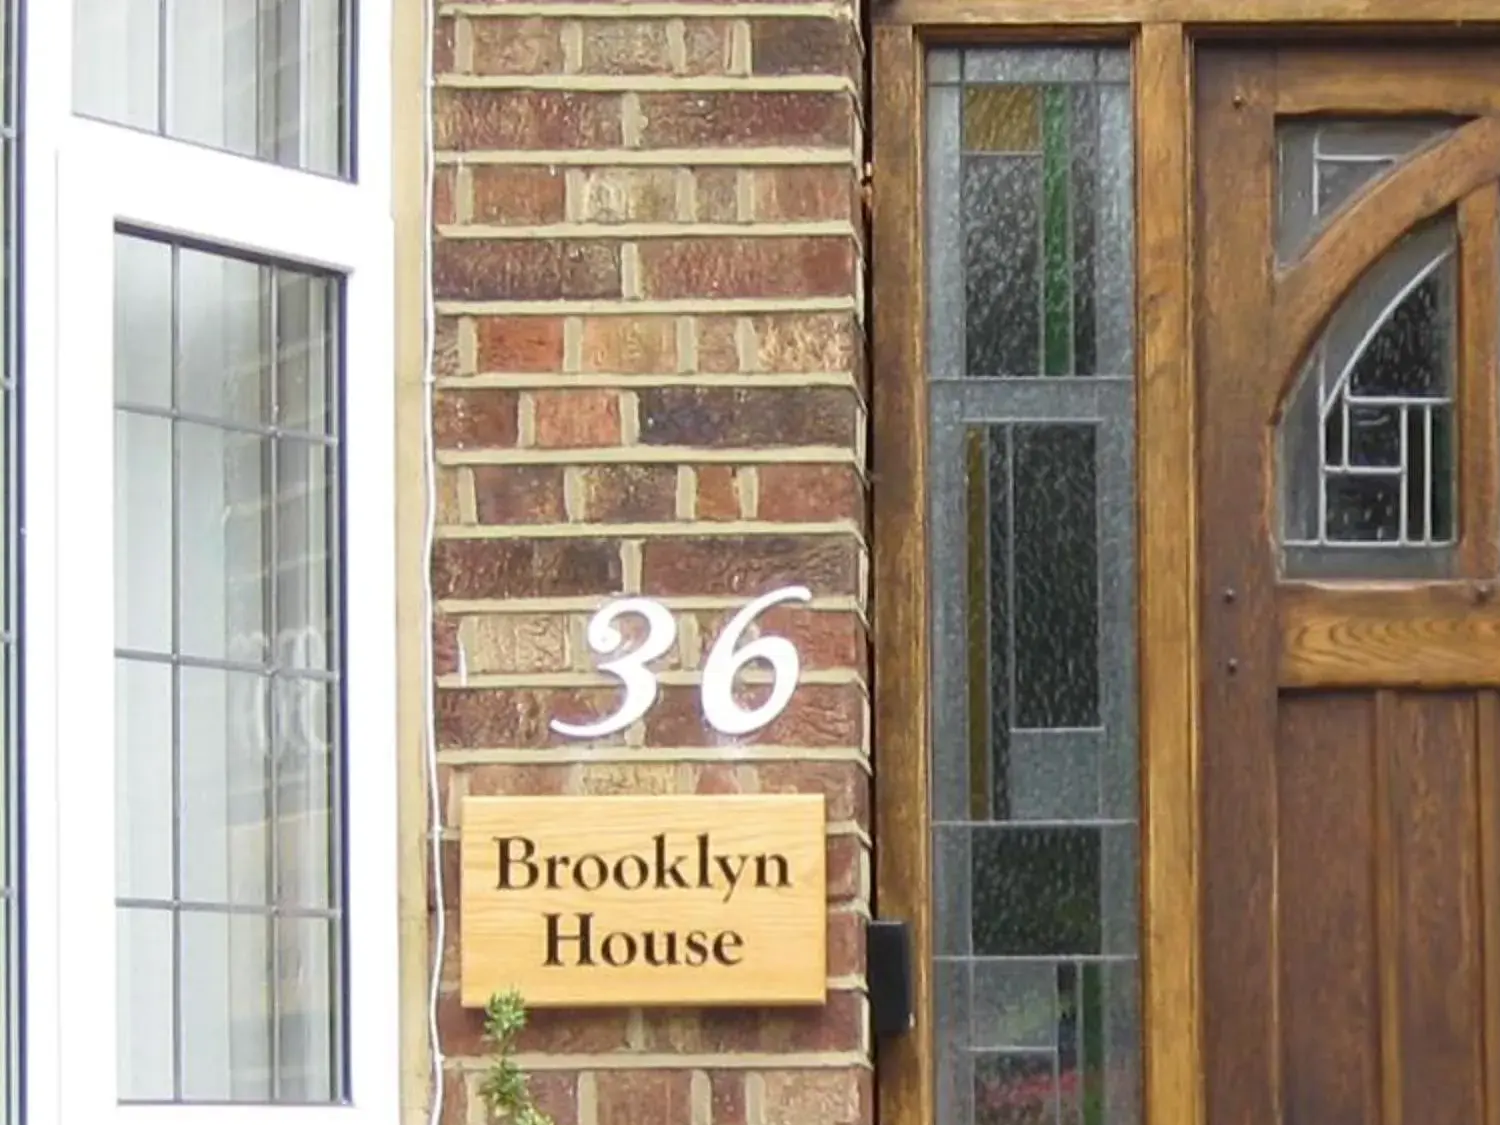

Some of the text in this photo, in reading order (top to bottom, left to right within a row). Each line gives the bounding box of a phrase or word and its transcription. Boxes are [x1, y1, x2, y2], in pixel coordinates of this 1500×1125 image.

[550, 586, 812, 737] 36
[492, 832, 791, 902] Brooklyn
[541, 912, 744, 967] House
